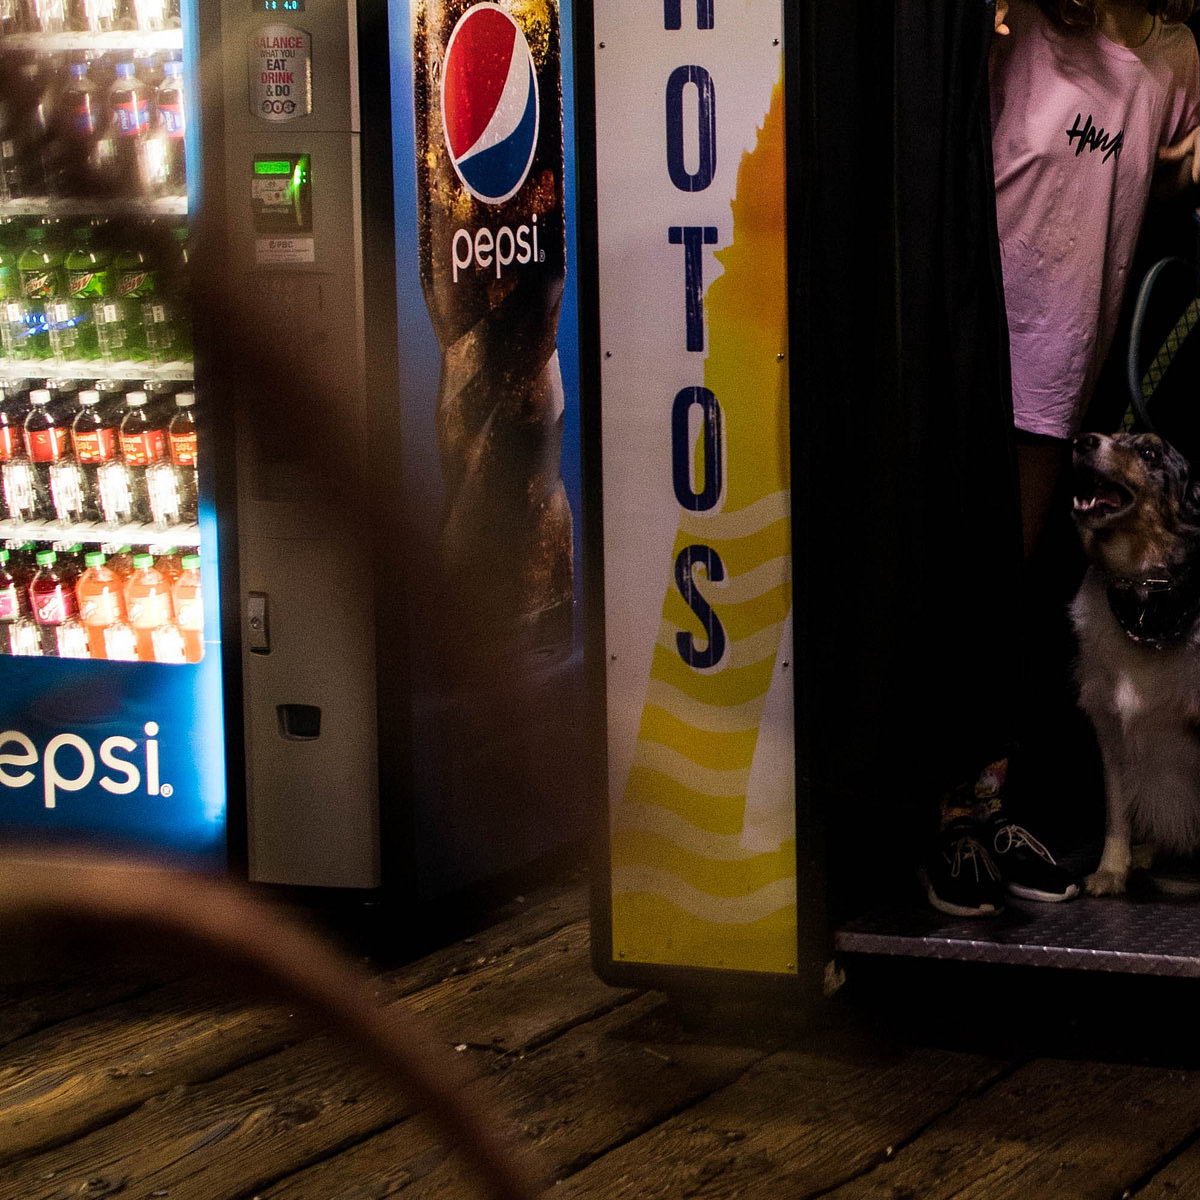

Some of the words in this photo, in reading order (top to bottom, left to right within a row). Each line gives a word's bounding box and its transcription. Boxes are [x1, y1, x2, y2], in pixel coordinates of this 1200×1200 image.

[254, 35, 304, 49] BALANCE
[261, 49, 278, 58] WHAT
[280, 49, 296, 58] YOU
[261, 71, 294, 84] DRINK
[265, 85, 273, 96] &
[275, 84, 290, 96] DO
[452, 213, 538, 283] pepsi
